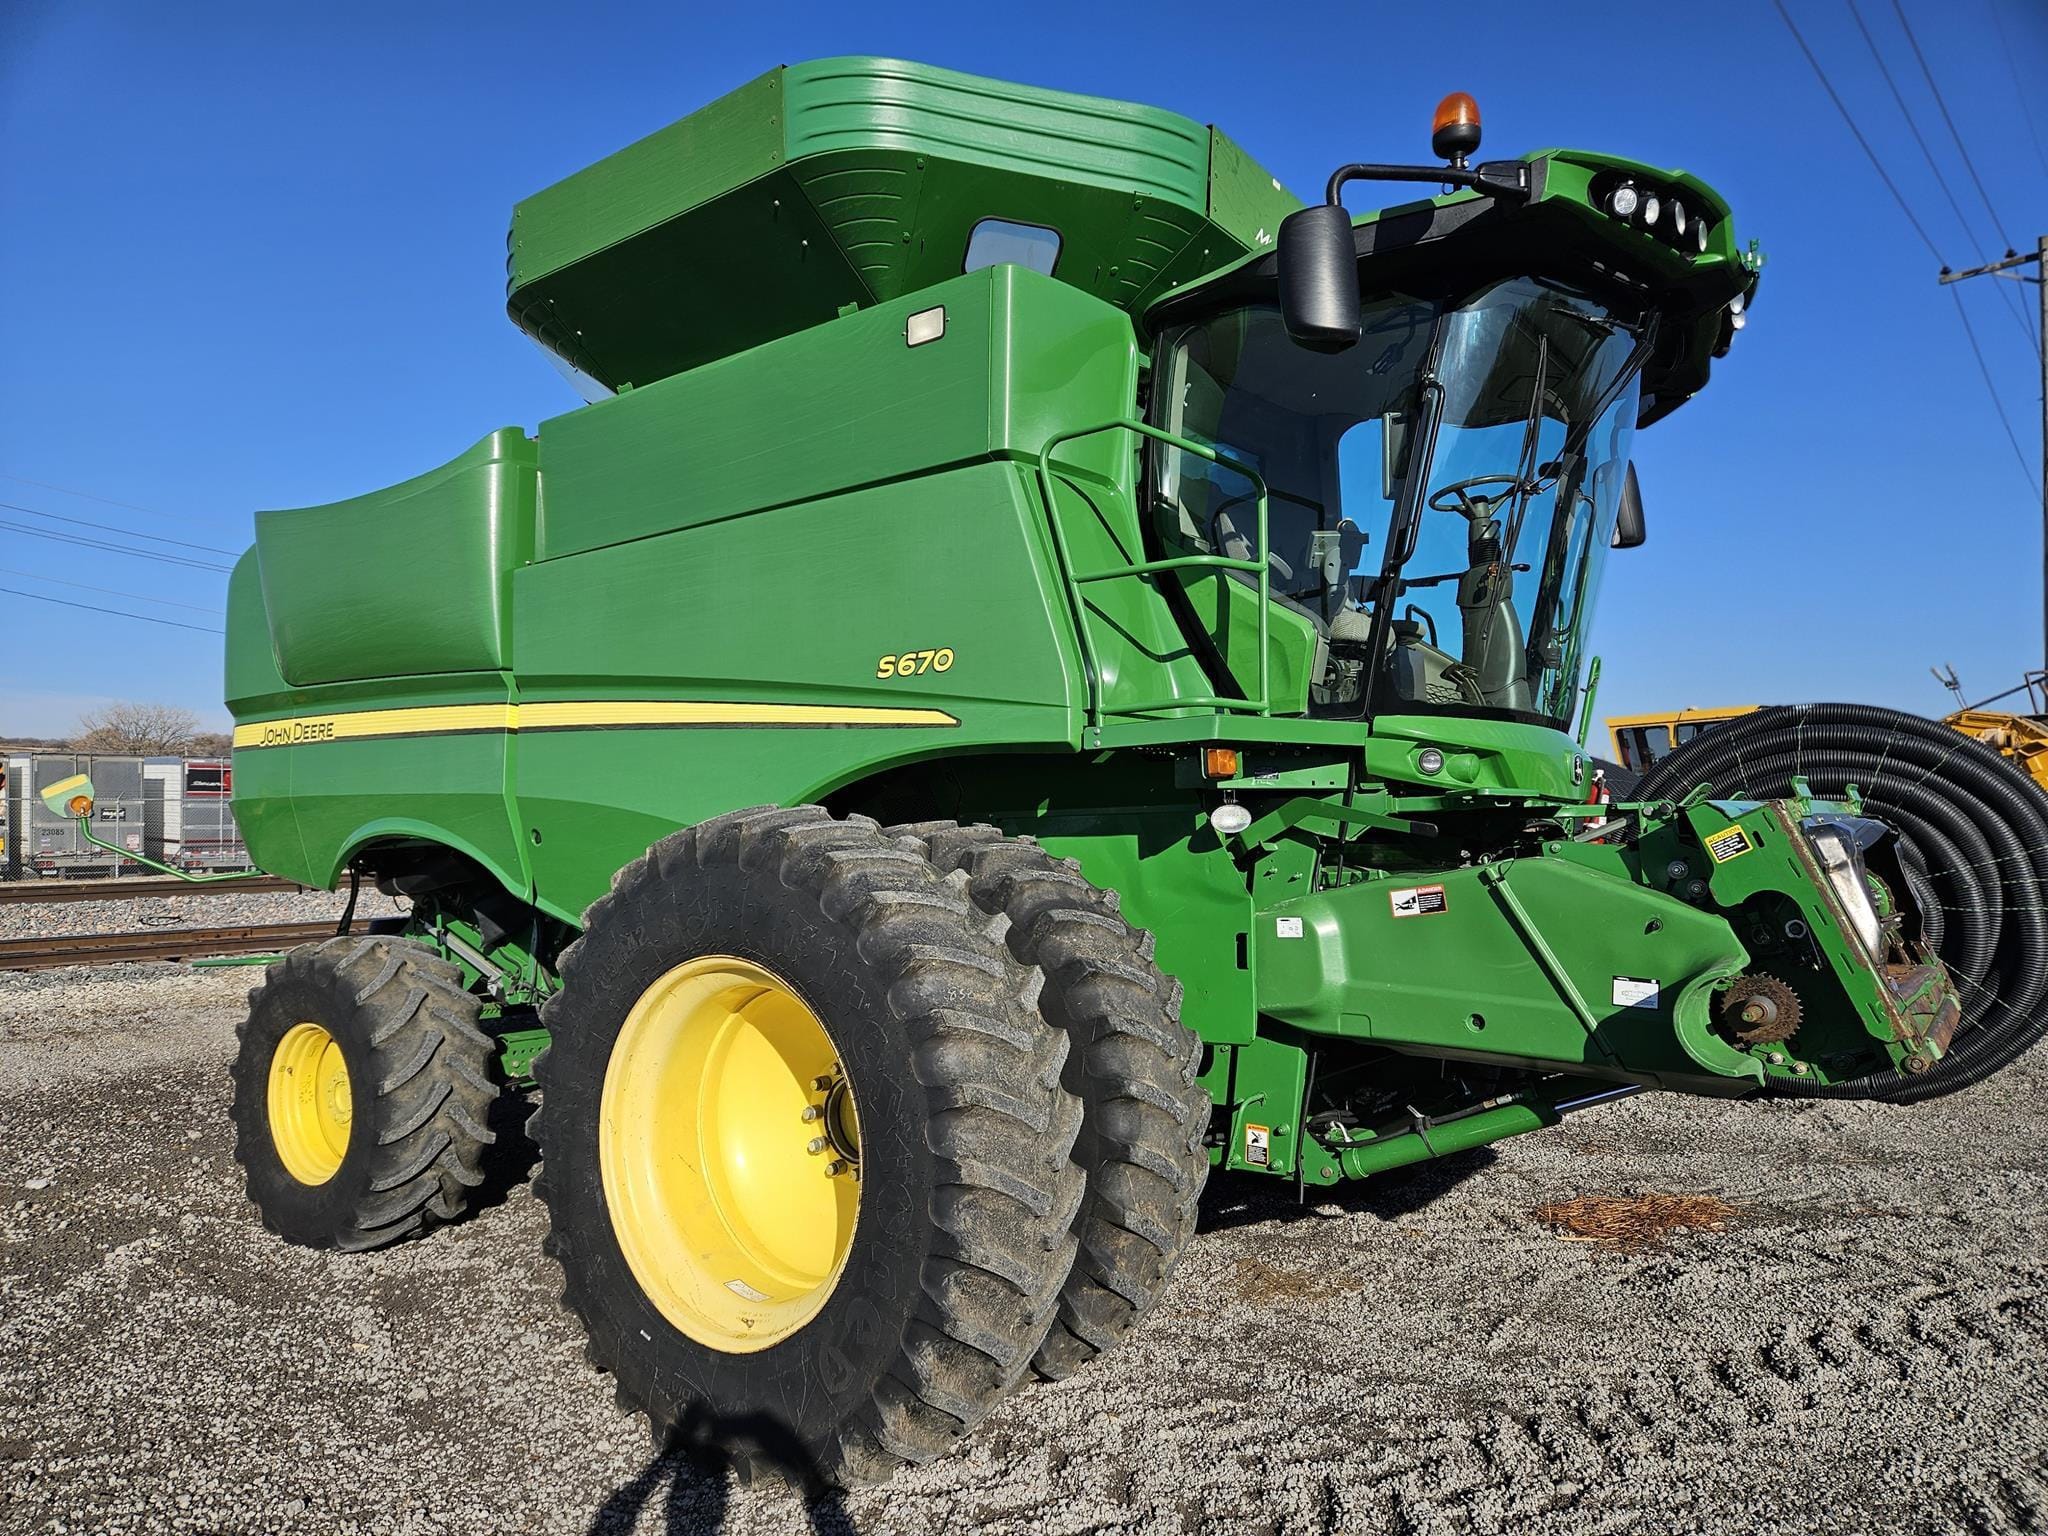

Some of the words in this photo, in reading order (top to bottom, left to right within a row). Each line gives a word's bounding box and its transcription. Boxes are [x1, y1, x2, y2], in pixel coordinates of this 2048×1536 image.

[876, 647, 955, 680] S670
[260, 727, 291, 745] JOHN
[294, 722, 334, 741] DEERE
